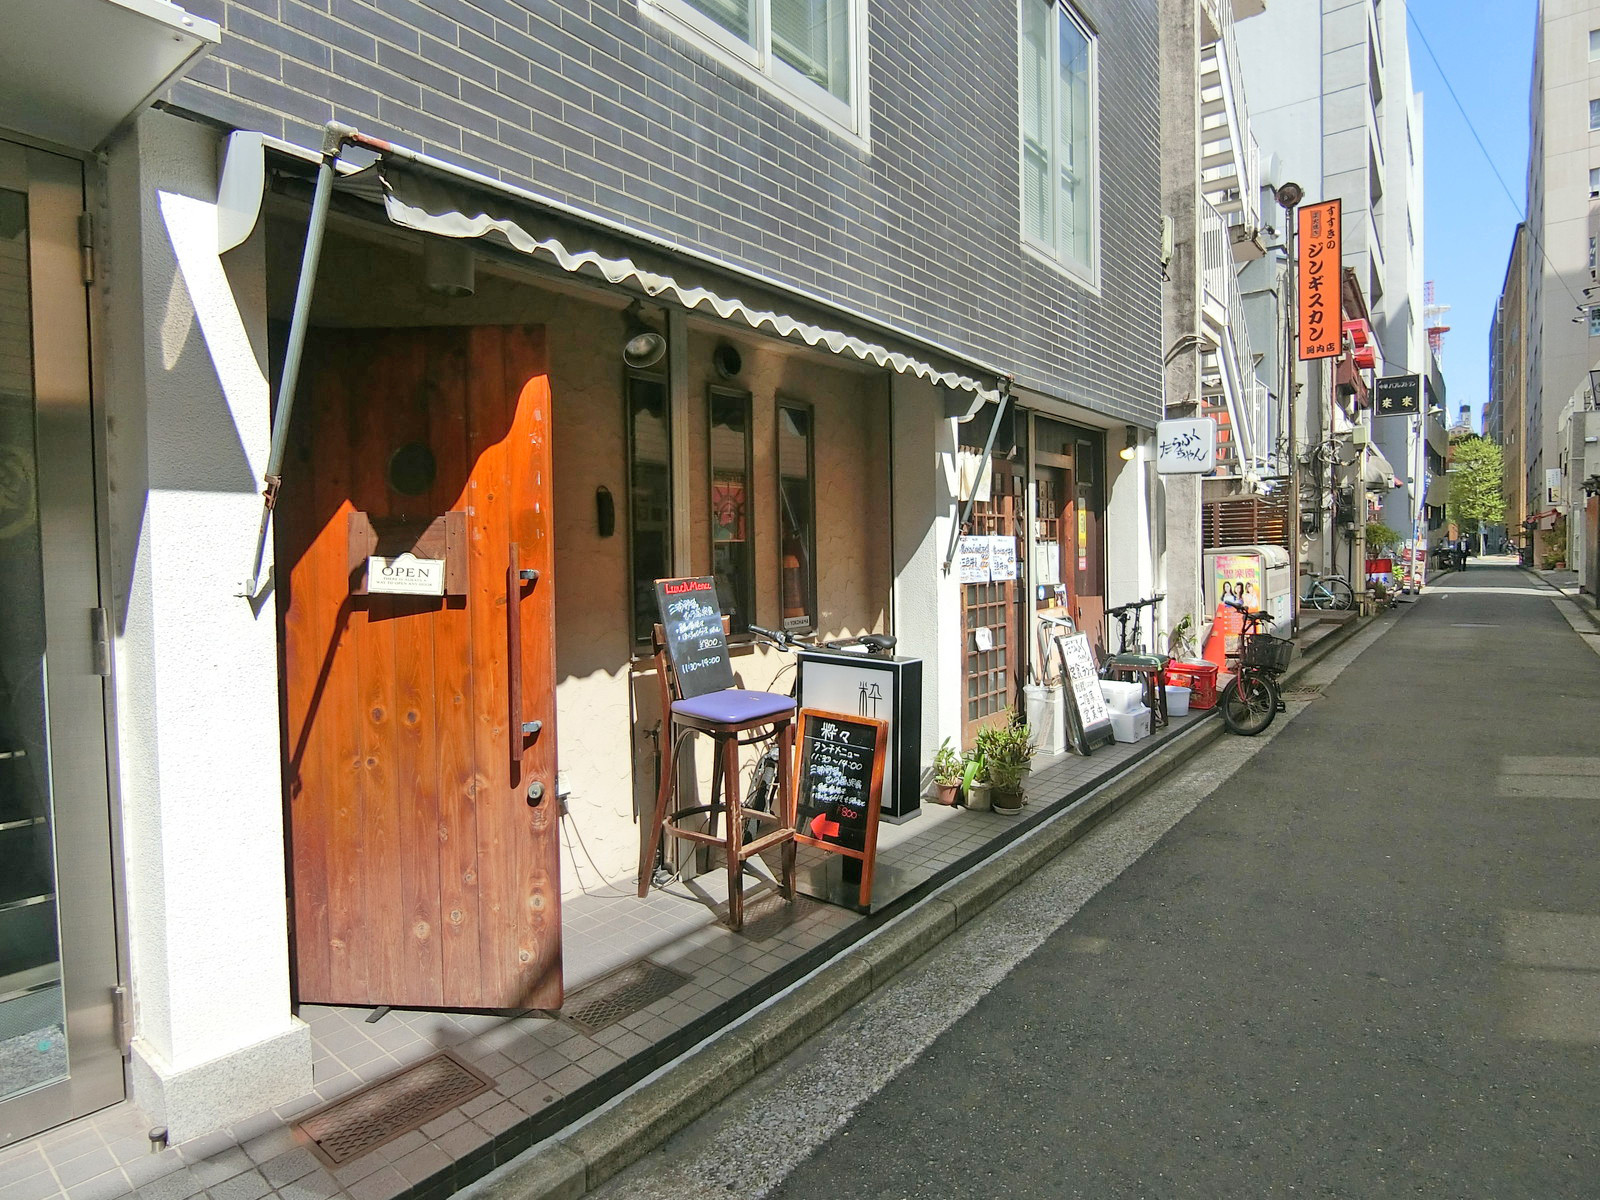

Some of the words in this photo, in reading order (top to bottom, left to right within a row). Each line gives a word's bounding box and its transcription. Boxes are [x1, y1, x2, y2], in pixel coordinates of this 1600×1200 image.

[1326, 205, 1336, 249] すすきの
[1308, 241, 1324, 342] ジンギスカン
[1160, 428, 1201, 459] たらふく
[1176, 447, 1208, 461] ちゃん
[382, 566, 430, 578] OPEN
[820, 721, 851, 744] 粋々
[813, 741, 861, 758] ランチメニュー
